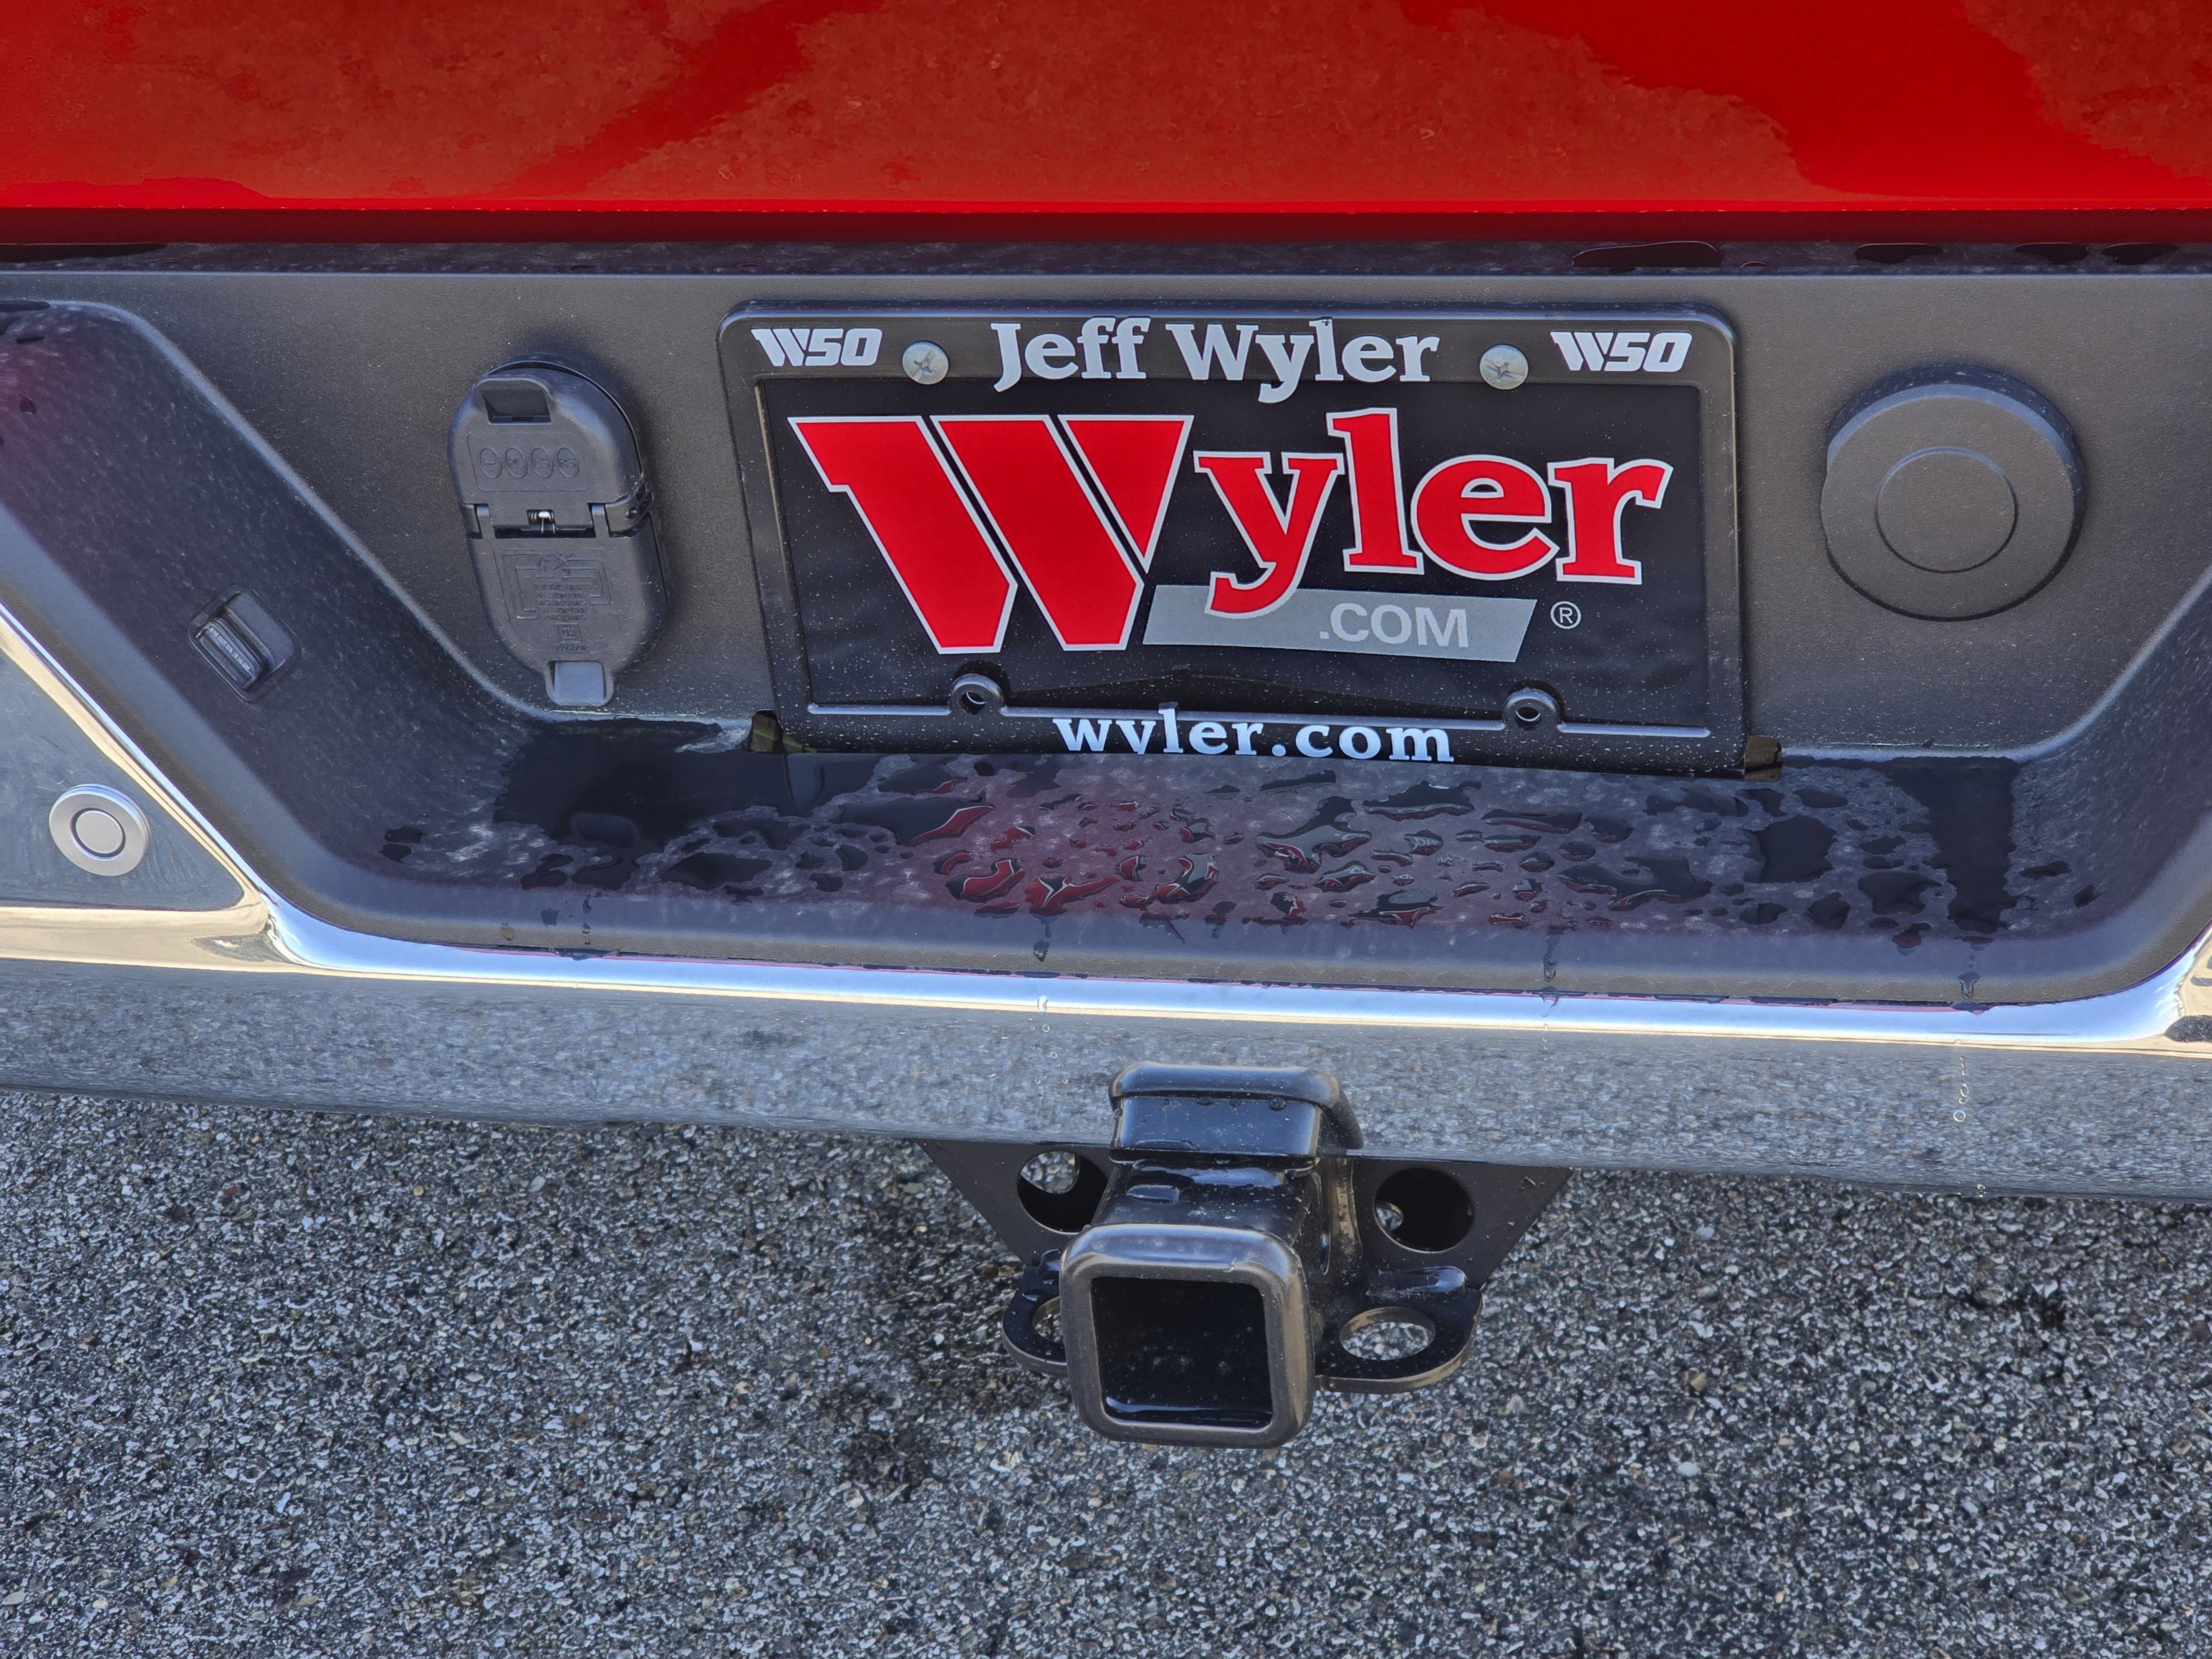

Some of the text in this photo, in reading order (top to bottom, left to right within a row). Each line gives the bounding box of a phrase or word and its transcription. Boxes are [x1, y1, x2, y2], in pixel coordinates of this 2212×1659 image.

[990, 317, 1440, 403] Jeff Wyler
[787, 407, 1674, 654] Wyler
[1319, 602, 1469, 648] .COM
